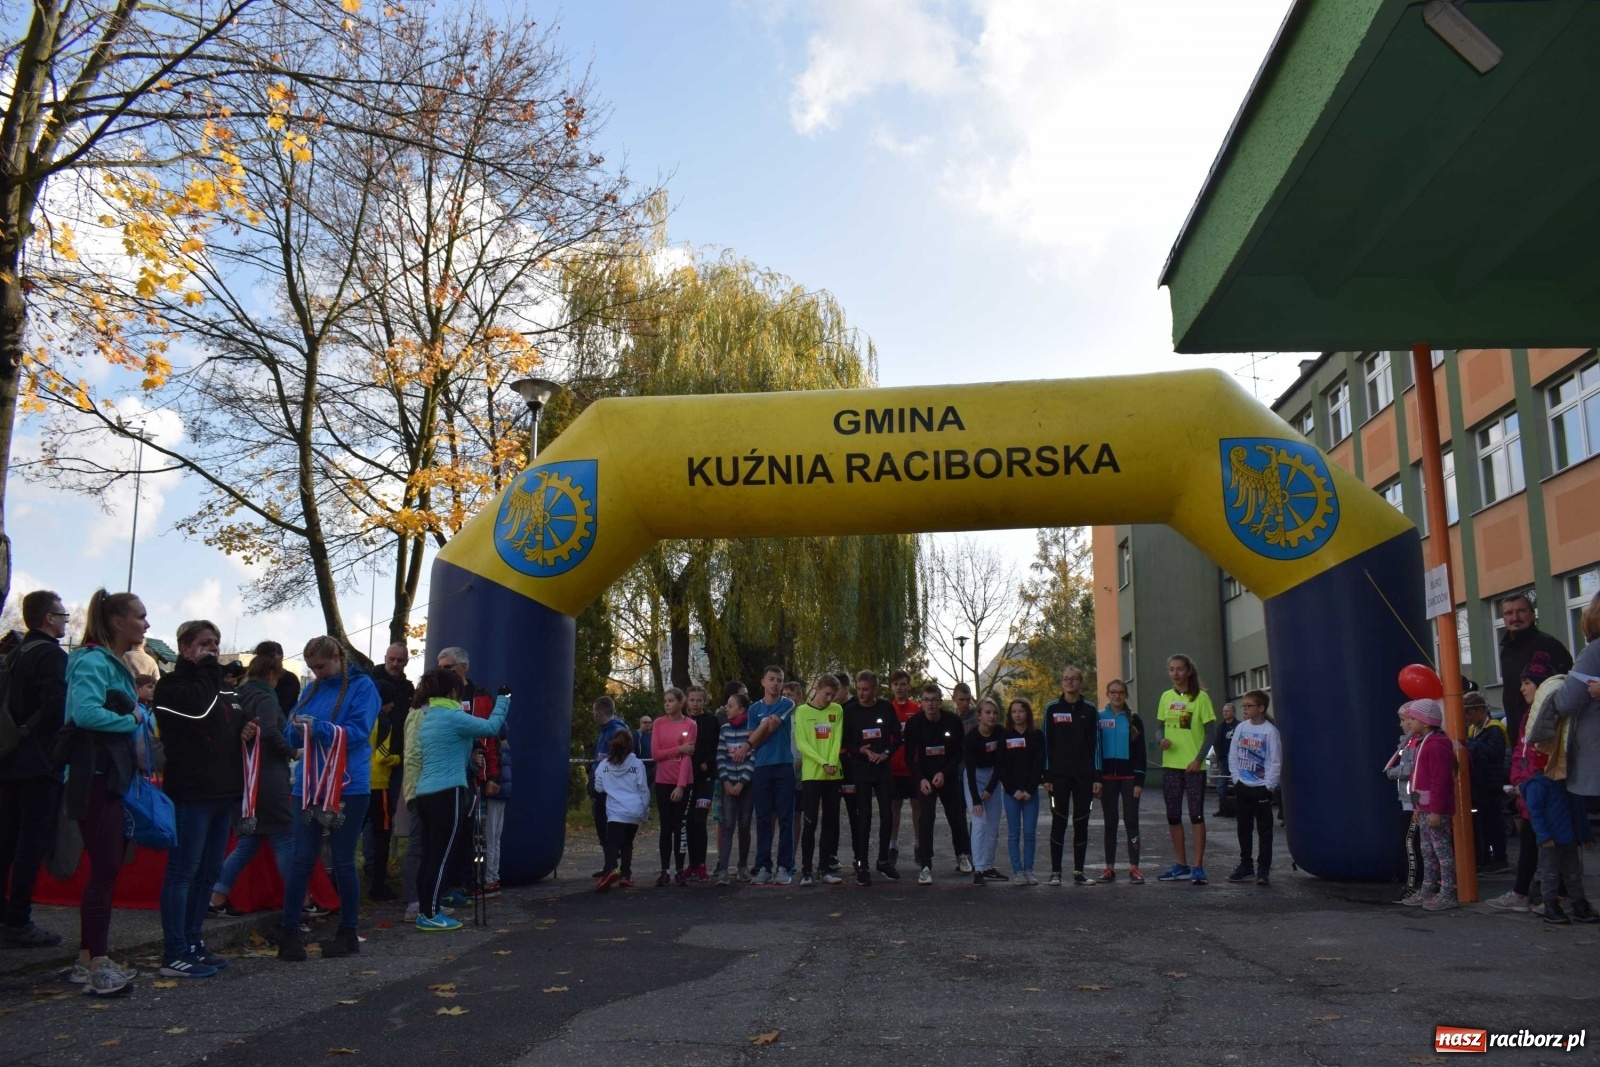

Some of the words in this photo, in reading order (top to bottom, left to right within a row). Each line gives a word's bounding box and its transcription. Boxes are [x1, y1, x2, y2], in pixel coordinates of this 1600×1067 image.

[833, 405, 965, 435] GMINA
[687, 448, 835, 487] KUŹNIA
[845, 443, 1121, 484] RACIBORSKA
